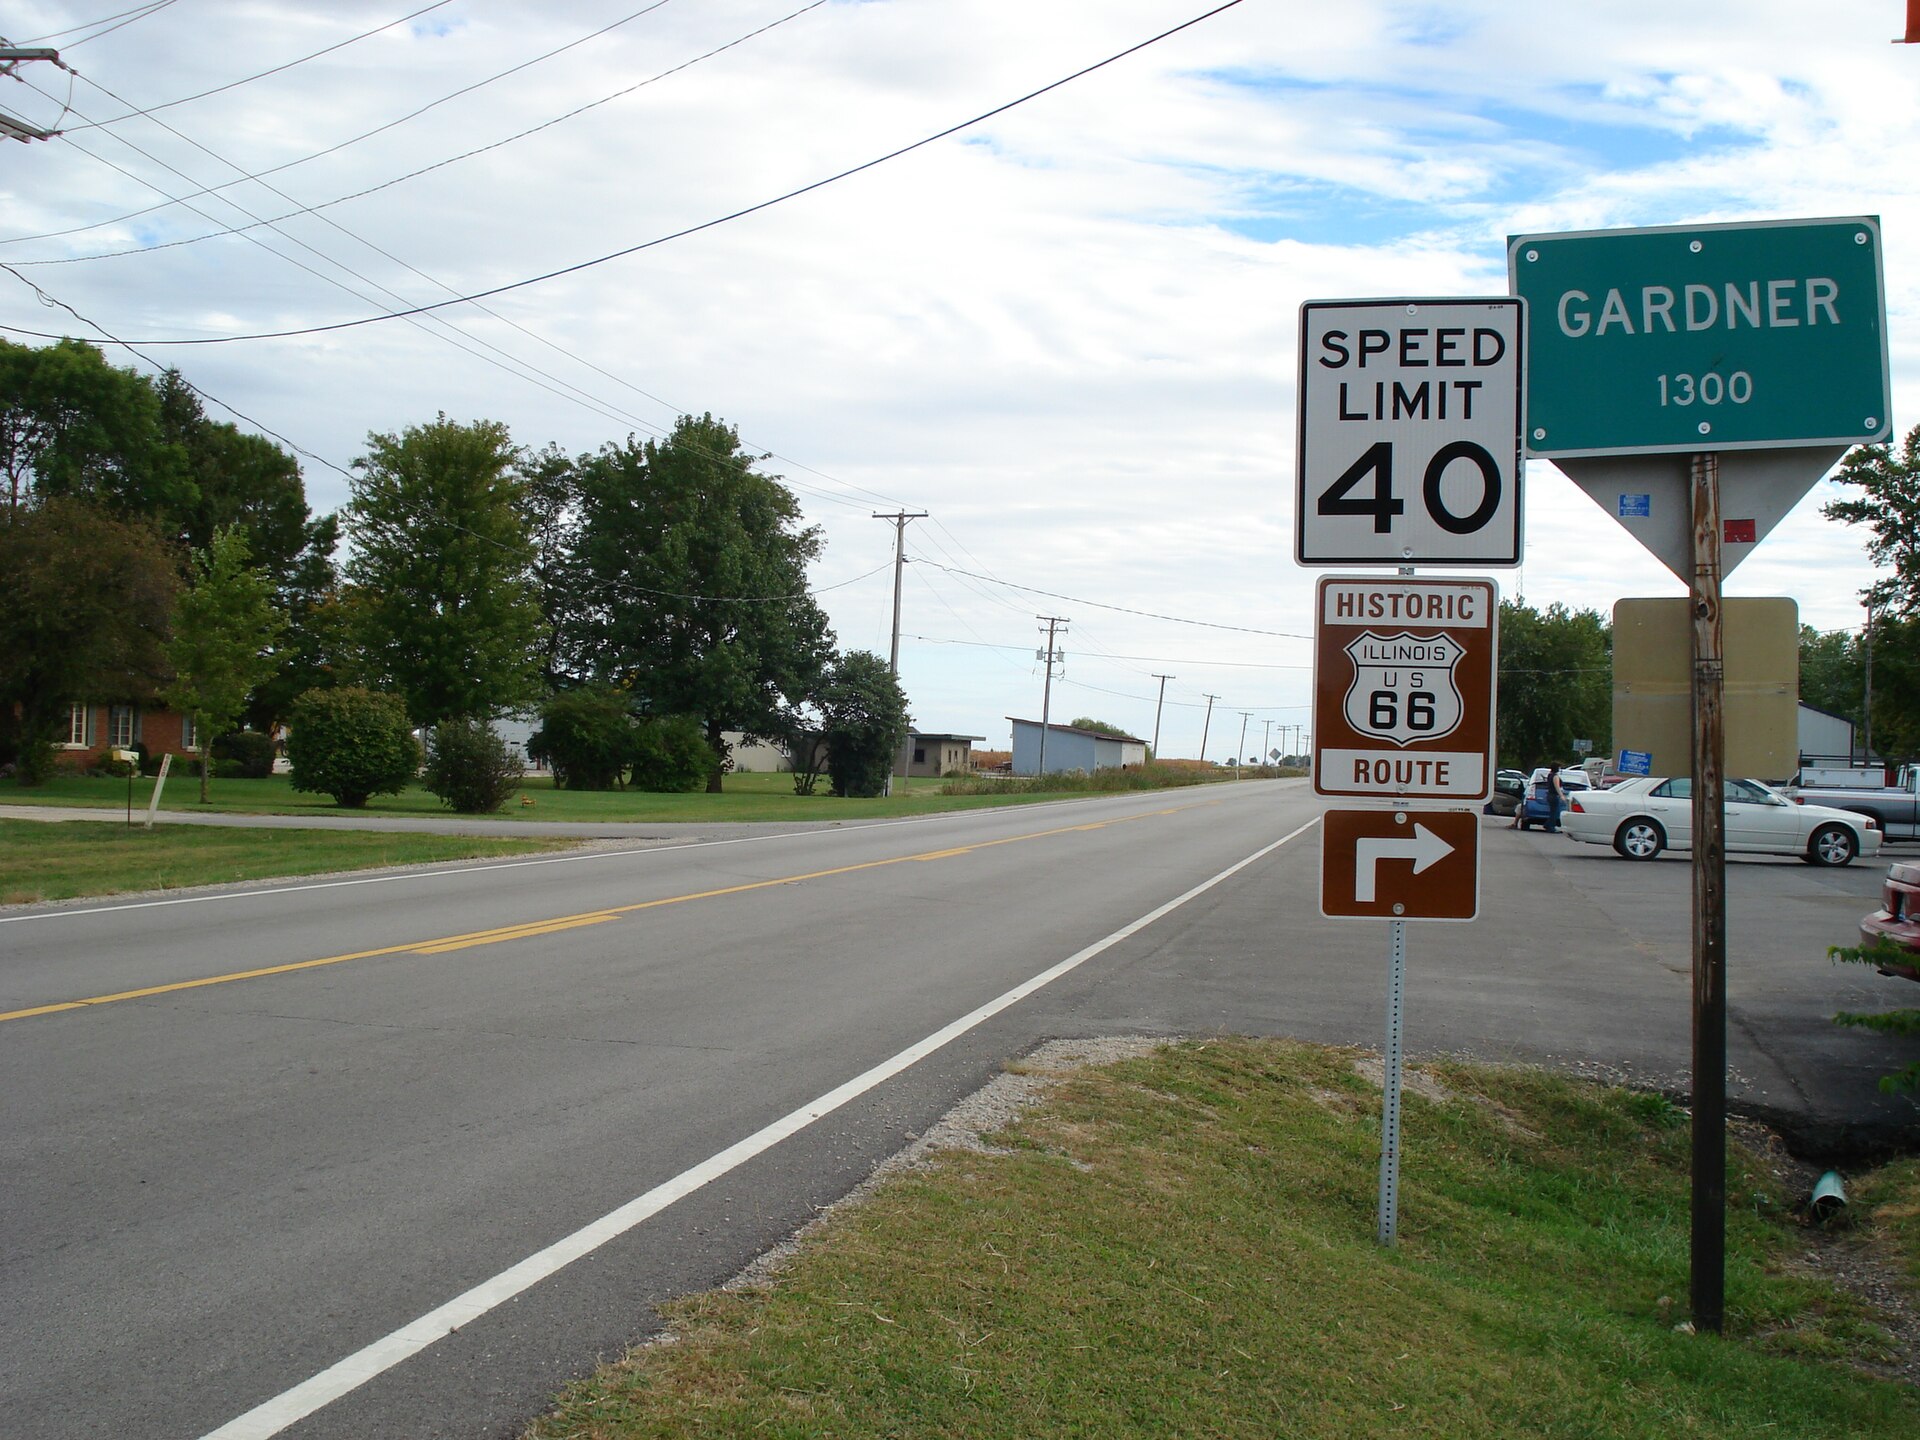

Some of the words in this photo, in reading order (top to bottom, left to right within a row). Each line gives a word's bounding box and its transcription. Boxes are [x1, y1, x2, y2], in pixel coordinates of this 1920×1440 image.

[1558, 278, 1839, 337] GARDNER
[1319, 328, 1505, 368] SPEED
[1340, 381, 1482, 420] LIMIT
[1657, 371, 1751, 406] 1300
[1318, 441, 1501, 534] 40
[1337, 592, 1473, 619] HISTORIC
[1364, 645, 1445, 660] ILLINOIS
[1369, 691, 1435, 730] 66
[1354, 759, 1449, 785] ROUTE
